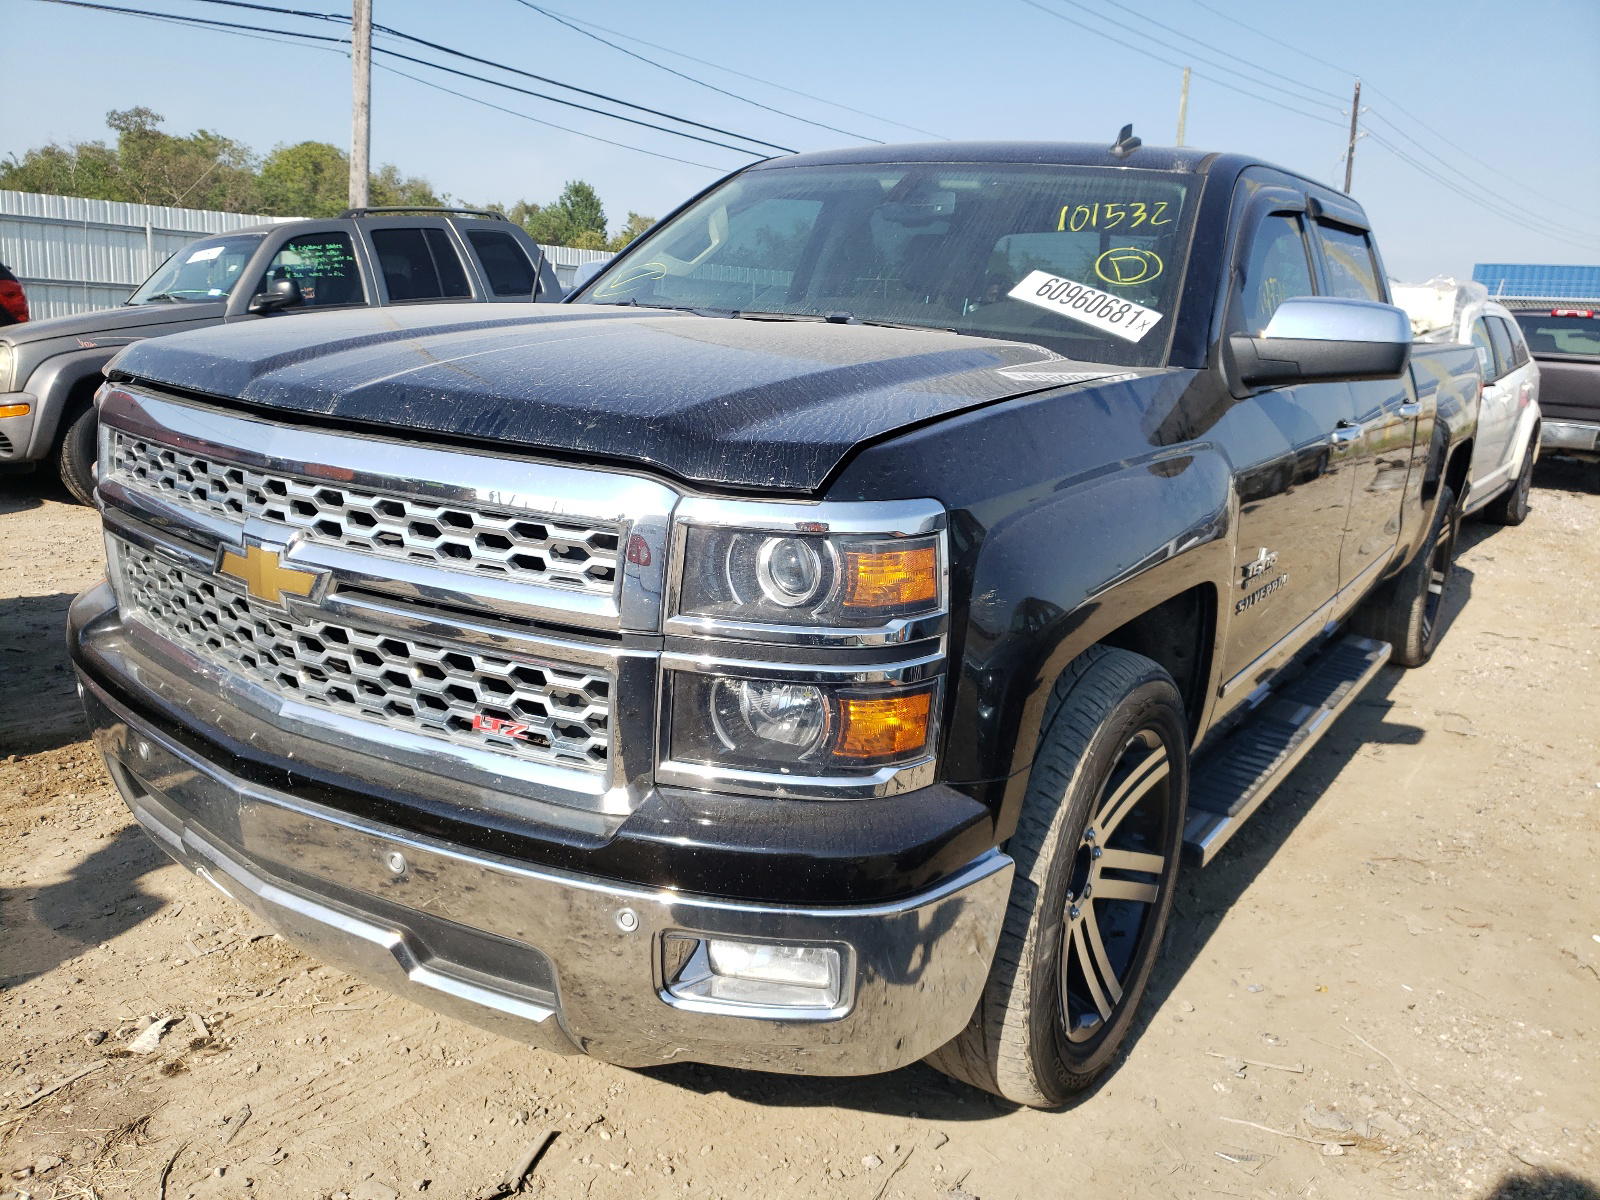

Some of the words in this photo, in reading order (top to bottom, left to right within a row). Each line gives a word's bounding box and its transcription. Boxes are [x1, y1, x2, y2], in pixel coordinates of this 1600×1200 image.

[1058, 202, 1172, 231] 101532
[1109, 255, 1147, 282] D
[472, 714, 529, 740] LTZ
